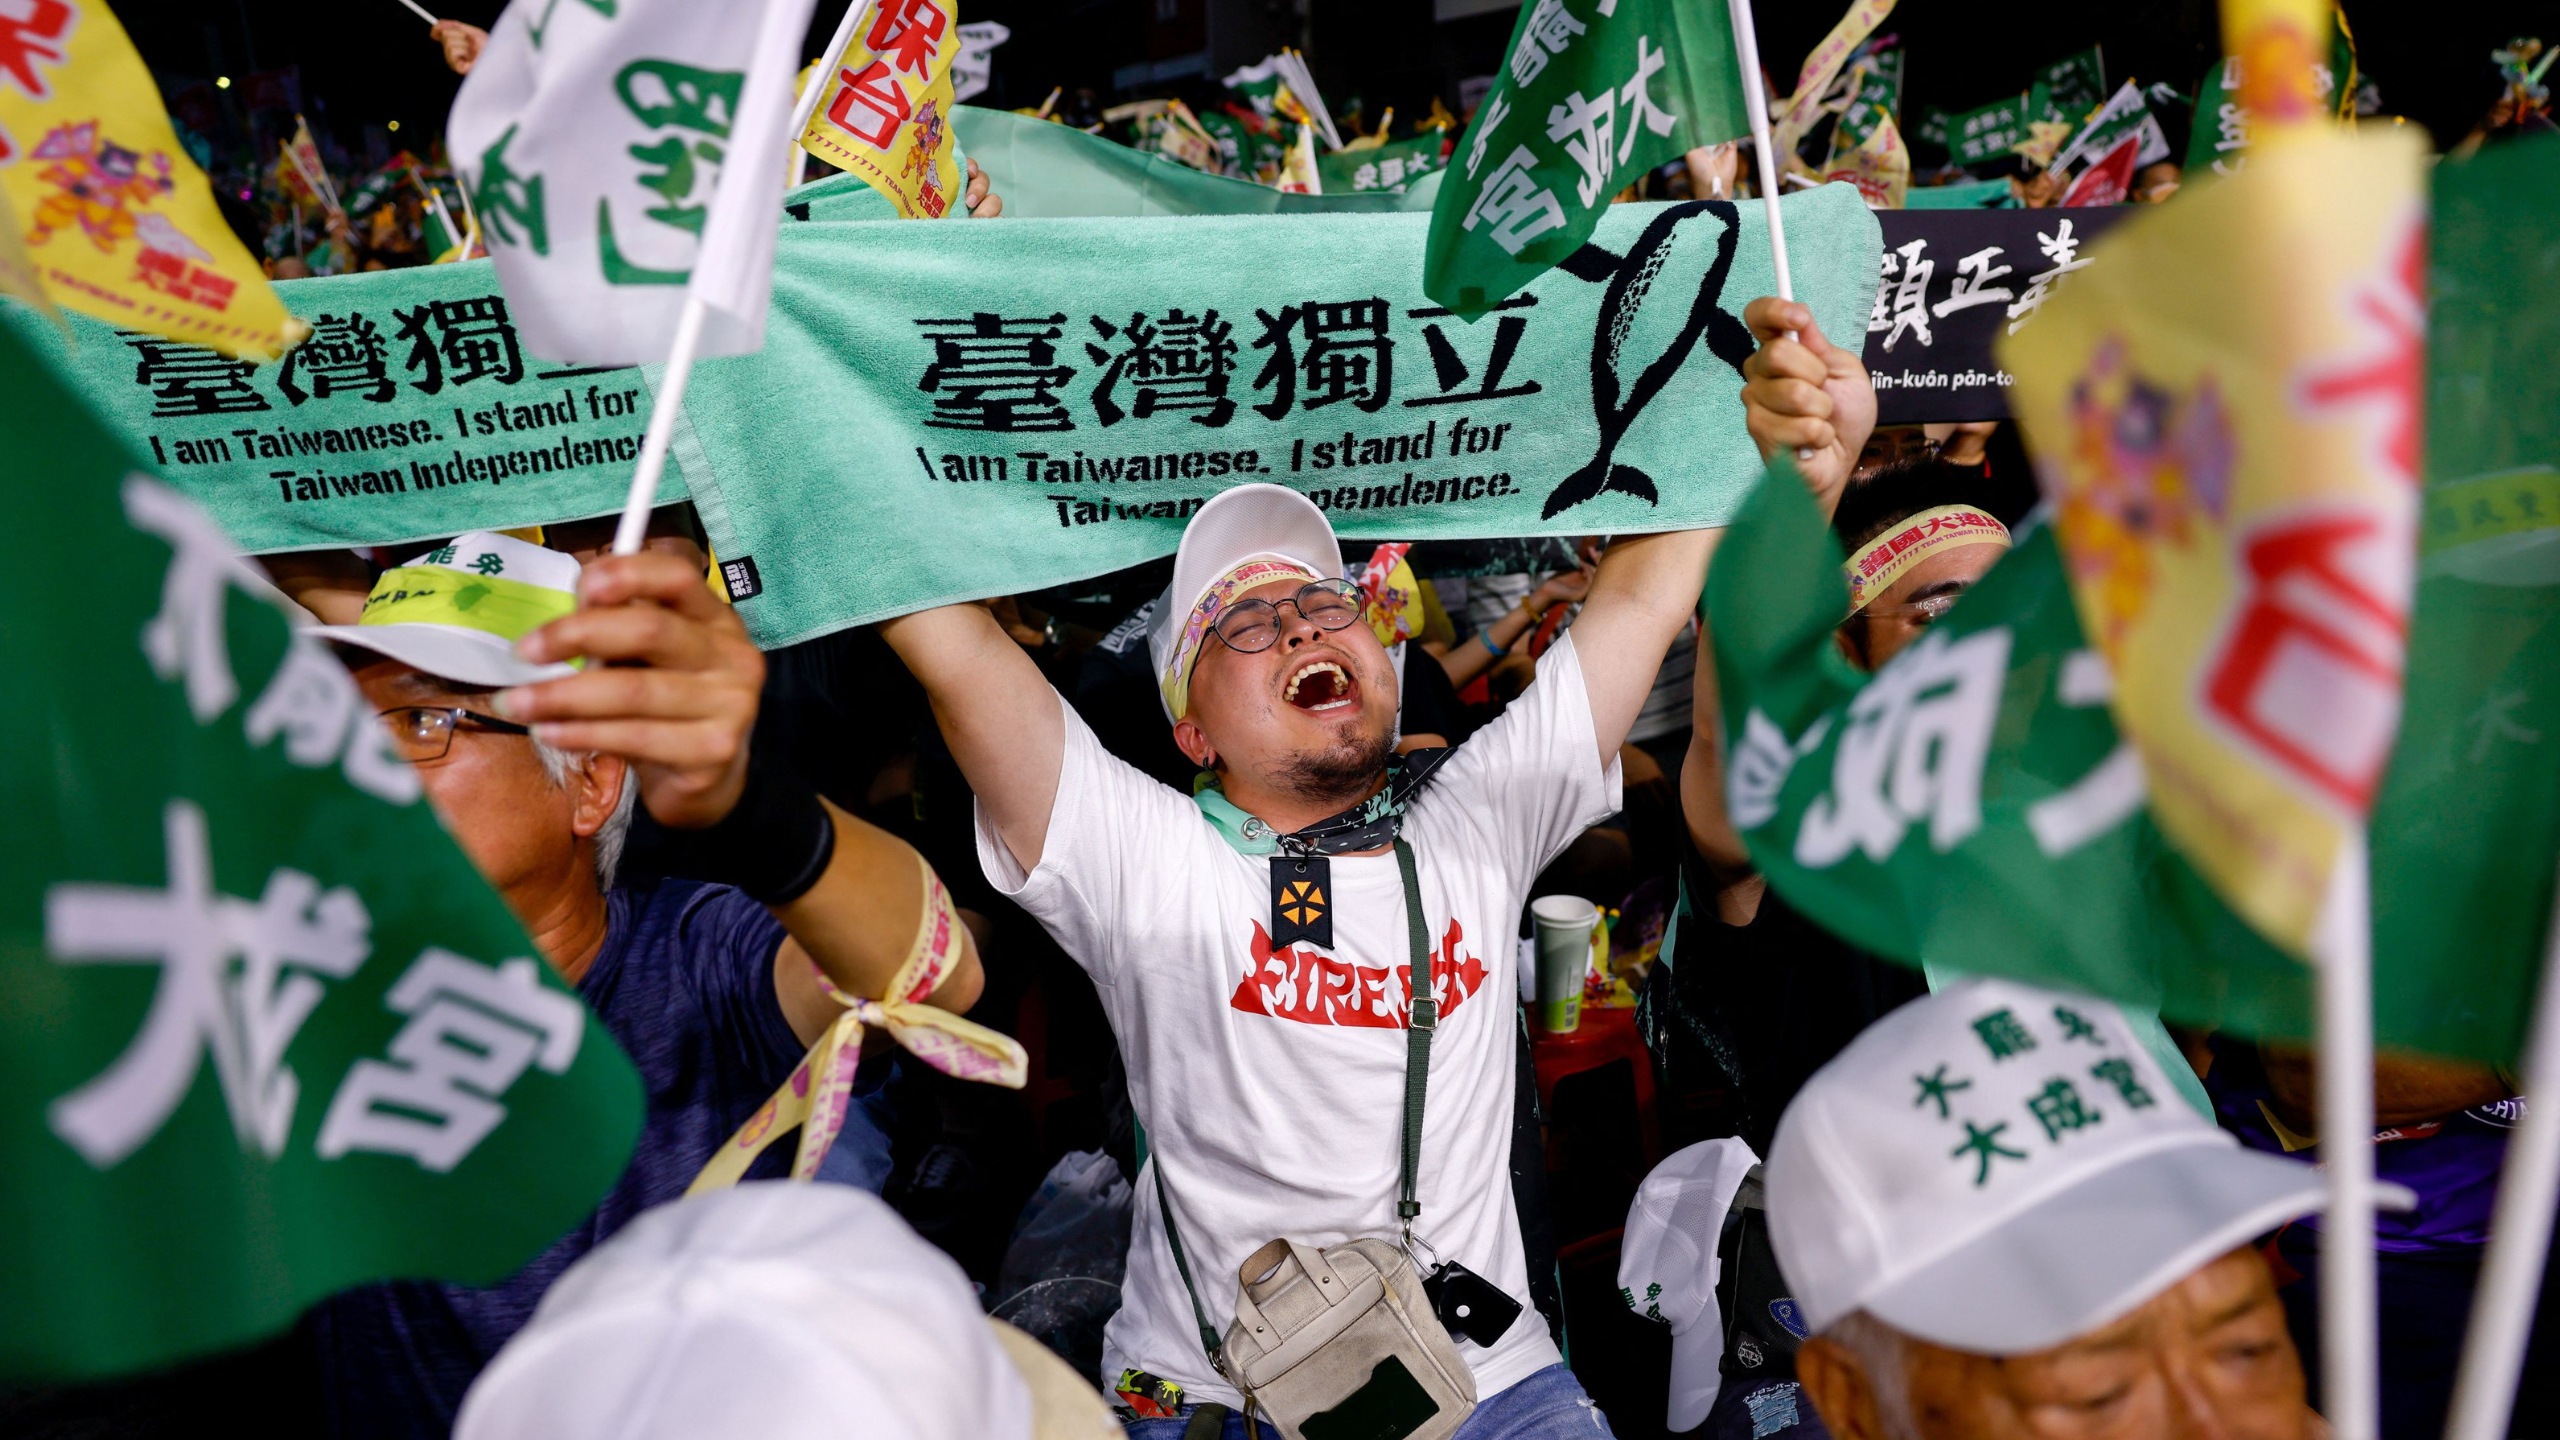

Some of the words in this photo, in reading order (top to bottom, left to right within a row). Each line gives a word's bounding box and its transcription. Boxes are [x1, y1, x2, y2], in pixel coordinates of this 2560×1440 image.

[829, 0, 947, 150] 保台
[114, 294, 640, 418] 臺灣獨
[912, 294, 1543, 433] 臺灣獨立
[1952, 368, 2017, 391] pān-to
[149, 435, 168, 465] I
[174, 437, 232, 465] am
[232, 419, 444, 460] Taiwanese.
[454, 407, 469, 438] I
[474, 389, 578, 435] stand
[584, 385, 639, 420] for
[915, 446, 938, 481] I
[941, 454, 1008, 483] am
[1016, 449, 1271, 484] Taiwanese.
[1290, 438, 1305, 473] I
[1311, 420, 1436, 470] stand
[1446, 416, 1512, 457] for
[270, 468, 407, 501] Taiwan
[409, 434, 660, 491] Independenc
[1047, 494, 1205, 528] Taiwan
[1276, 472, 1521, 513] pendence.
[1950, 1056, 2157, 1188] 大成宮
